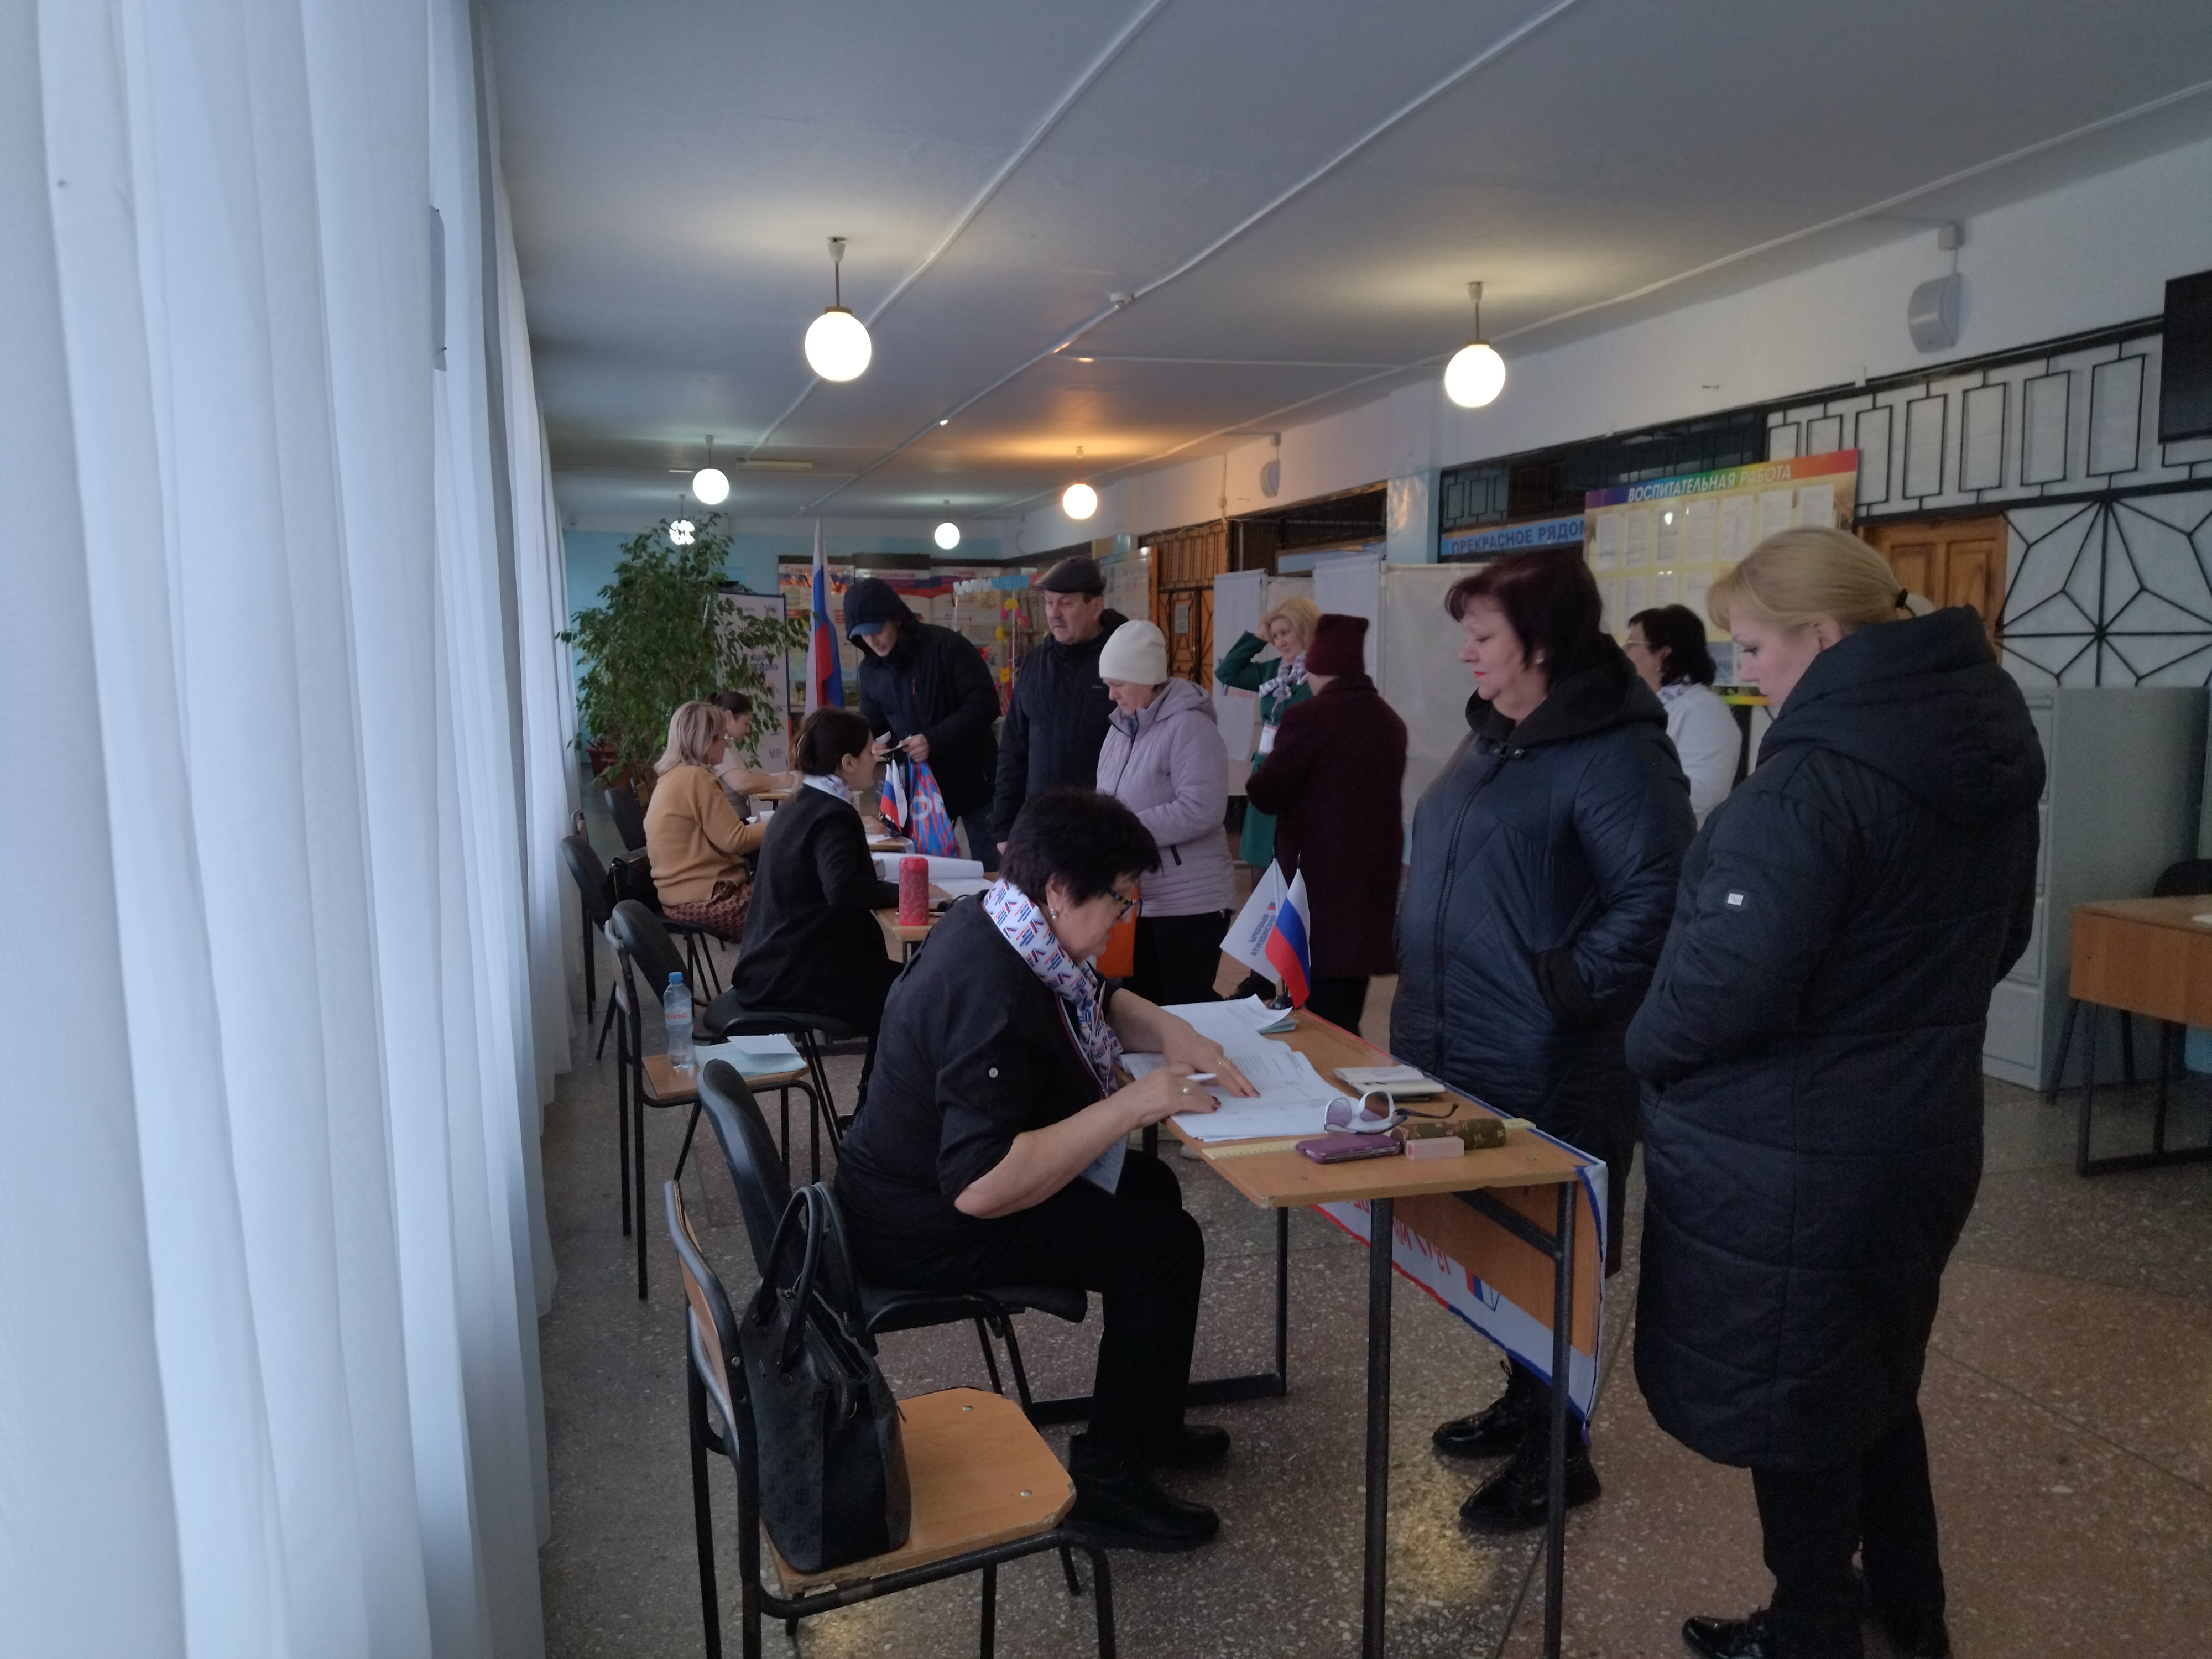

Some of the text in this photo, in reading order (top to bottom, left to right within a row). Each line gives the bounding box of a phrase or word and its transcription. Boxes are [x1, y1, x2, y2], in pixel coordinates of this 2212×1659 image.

[1628, 465, 1791, 503] ВОСПИТАТЕЛЬНАЯ РАБОТА
[1453, 529, 1533, 554] ПРЕКРАСНОЕ
